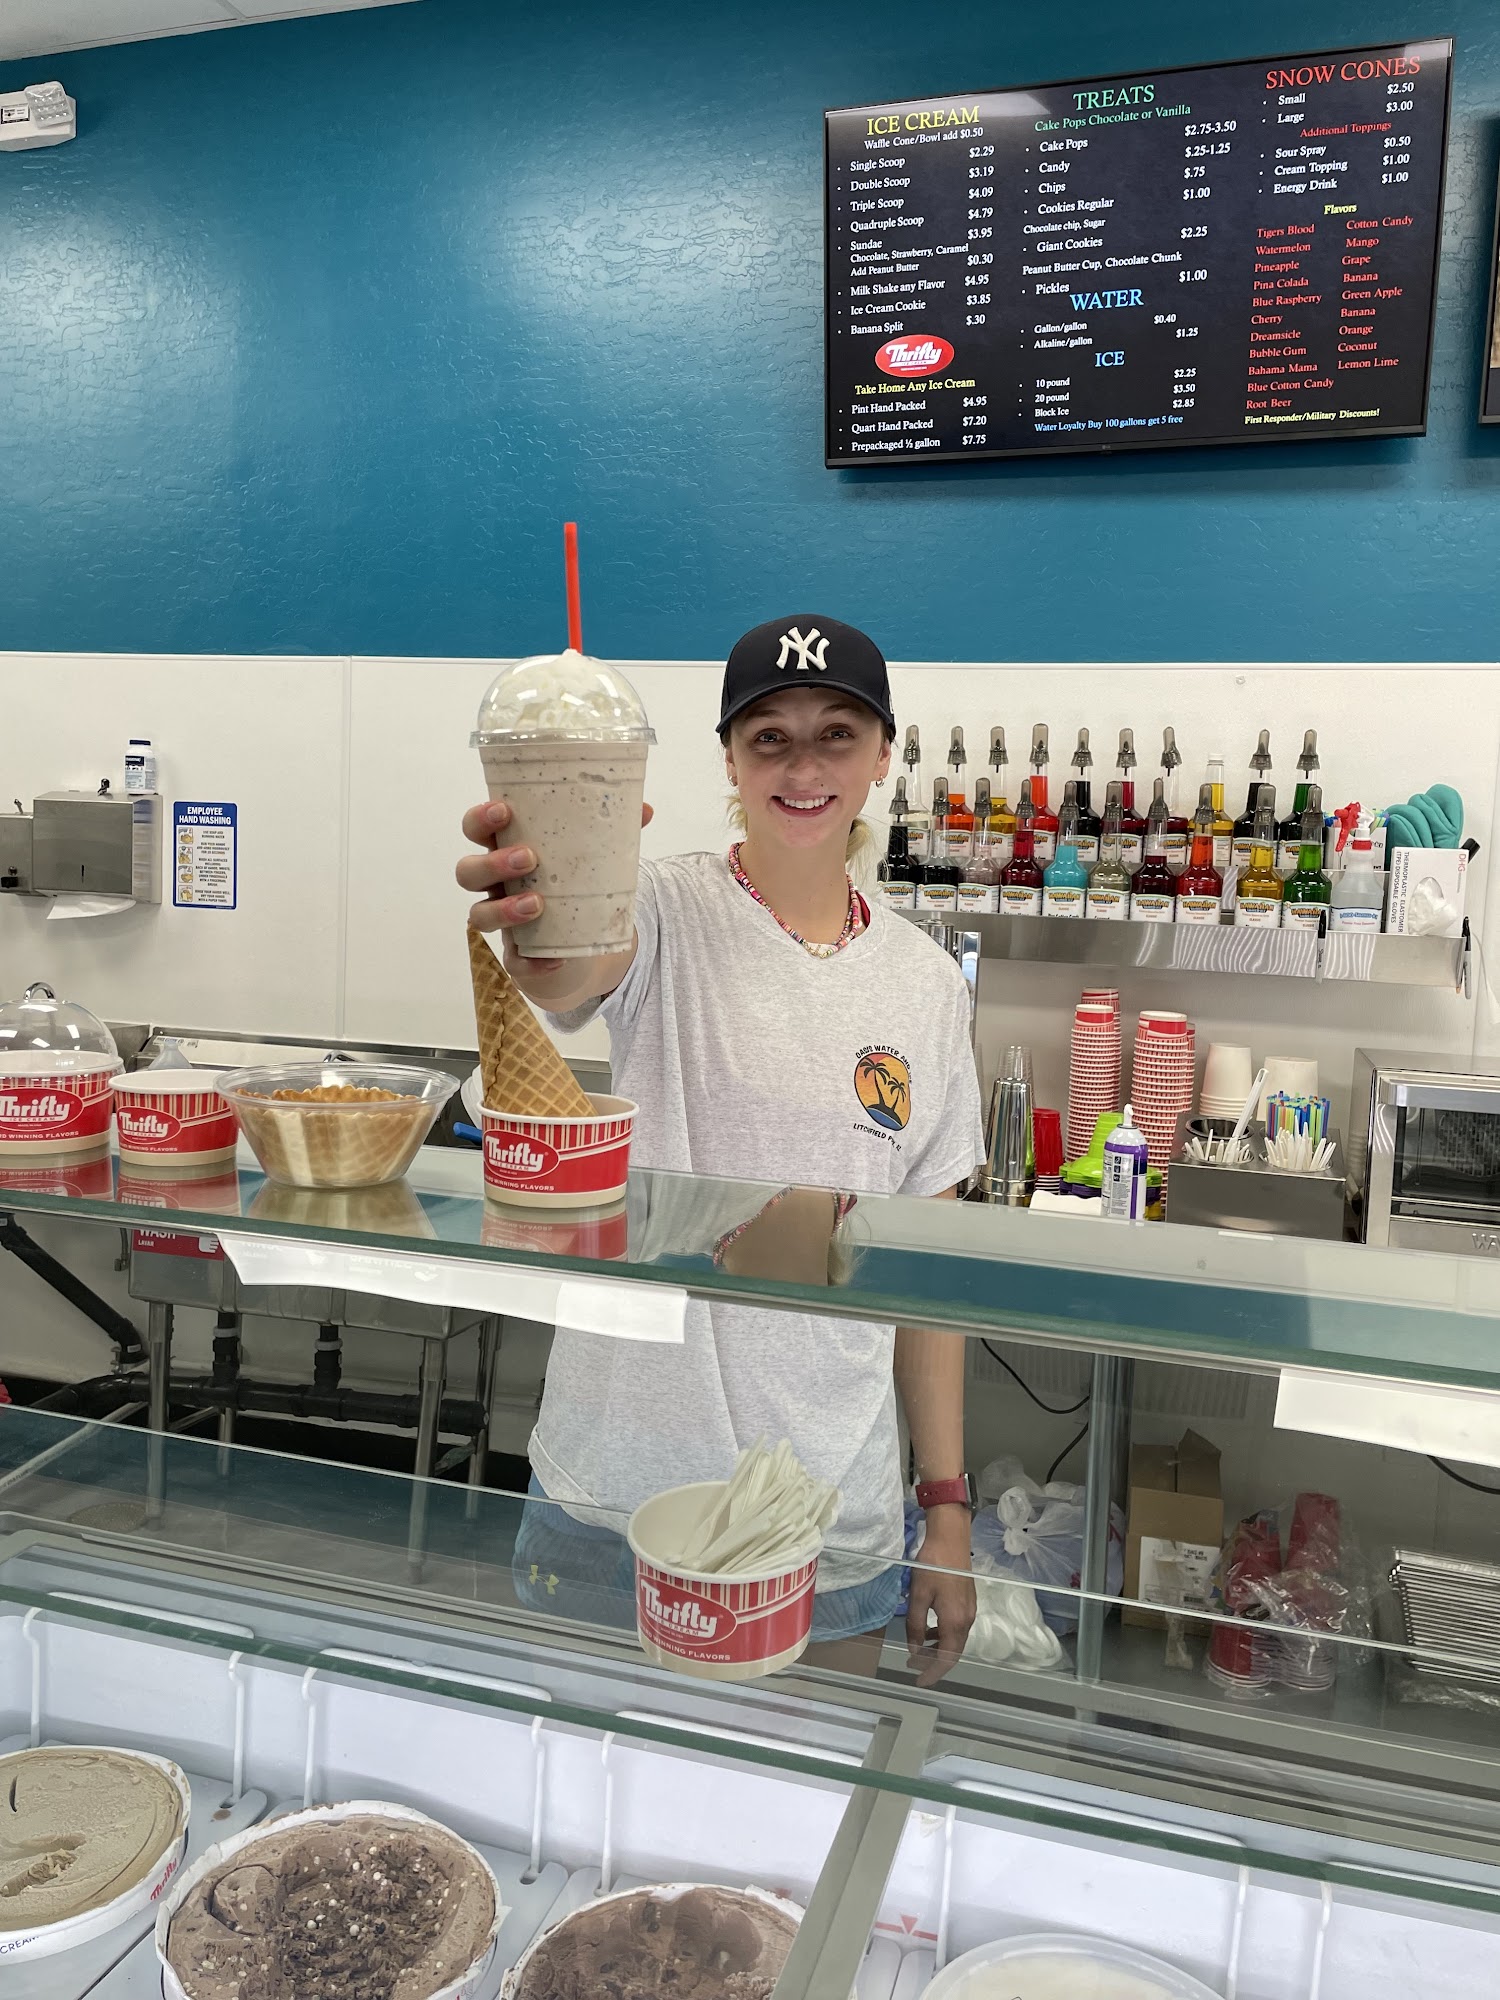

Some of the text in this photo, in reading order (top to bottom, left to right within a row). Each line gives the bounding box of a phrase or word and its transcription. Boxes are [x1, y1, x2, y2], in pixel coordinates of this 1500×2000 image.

[1266, 56, 1420, 89] SNOW CONES
[1387, 82, 1414, 95] $2.50
[1073, 85, 1154, 110] TREATS
[1278, 93, 1305, 105] Small
[867, 105, 980, 135] ICE CREAM
[1035, 104, 1190, 131] Cake Pops Chocolate or Vanilla
[1185, 120, 1236, 137] $2.75-3.50
[1300, 123, 1391, 137] Additional Toppings
[864, 127, 983, 149] Waffle Cone/Bowl add $0.50
[969, 145, 994, 158] $2.29
[1185, 142, 1230, 158] $.25-1.25
[850, 158, 905, 172] Single Scoop
[1383, 153, 1410, 166] $1.00
[1039, 161, 1070, 173] Candy
[1184, 166, 1205, 179] $.75
[1274, 160, 1348, 175] Cream Topping
[1038, 182, 1066, 194] Chips
[1273, 178, 1337, 194] Energy Drink
[1183, 187, 1210, 200] $1.00
[1038, 198, 1114, 214] Cookies Regular
[1324, 204, 1357, 214] Flavors
[968, 207, 993, 220] $4.79
[850, 216, 924, 233] Quadruple Scoop
[1023, 219, 1106, 234] Chocolate chip, Sugar
[1346, 216, 1413, 229] Cotton Candy
[968, 227, 992, 240] $3.95
[1257, 224, 1314, 239] Tigers Blood
[850, 239, 882, 251] Sundae
[1256, 243, 1310, 255] Watermelon
[1346, 238, 1379, 248] Mango
[850, 243, 969, 263] Chocolate, Strawberry, Caramel
[967, 253, 993, 266] $0.30
[1023, 251, 1182, 275] Peanut Butter Cup, Chocolate Chunk
[1255, 261, 1299, 272] Pineapple
[1342, 256, 1371, 266] Grape
[965, 274, 989, 286] $4.95
[1179, 269, 1207, 283] $1.00
[1343, 273, 1378, 282] Banana
[850, 280, 945, 296] Milk Shake any Flavor
[1036, 282, 1069, 294] Pickles
[1342, 287, 1402, 299] Green Apple
[1069, 289, 1144, 311] WATER
[1253, 294, 1322, 307] Blue Raspberry
[966, 314, 985, 326] $.30
[1154, 314, 1176, 324] $0.40
[1251, 315, 1283, 324] Cherry
[851, 321, 904, 334] Banana Split
[1034, 322, 1087, 333] Gallon/gallon
[1176, 327, 1198, 338] $1.25
[1339, 326, 1373, 335] Orange
[1251, 330, 1301, 342] Dreamsicle
[1034, 337, 1092, 349] Alkaline/gallon
[1338, 342, 1377, 352] Coconut
[885, 341, 942, 368] Thrifty
[1095, 351, 1124, 367] ICE
[1250, 347, 1306, 358] Bubble Gum
[1338, 358, 1399, 369] Lemon Lime
[1174, 368, 1196, 378] $2.25
[855, 379, 975, 395] Take Home Any Ice Cream
[1036, 377, 1070, 389] 10 pound
[852, 400, 926, 414] Pint Hand Packed
[1245, 408, 1380, 424] First Responder/Military Discounts!
[1034, 415, 1183, 431] Water Loyalty Buy 100 gallons get 5 free
[851, 438, 940, 452] Prepackaged ½ gallon
[962, 434, 986, 445] $7.75
[776, 626, 830, 671] NY
[187, 806, 223, 816] EMPLOYEE
[179, 815, 231, 825] HAND WASHING
[1400, 852, 1409, 897] THERMOPLASTIC
[1390, 902, 1398, 923] GLOVES
[874, 1045, 899, 1056] WATER
[0, 1096, 70, 1121] Thrifty
[119, 1112, 168, 1136] Thrifty
[485, 1135, 544, 1171] Thrifty
[641, 1579, 717, 1636] Thrifty
[688, 1650, 731, 1660] FLAVORS
